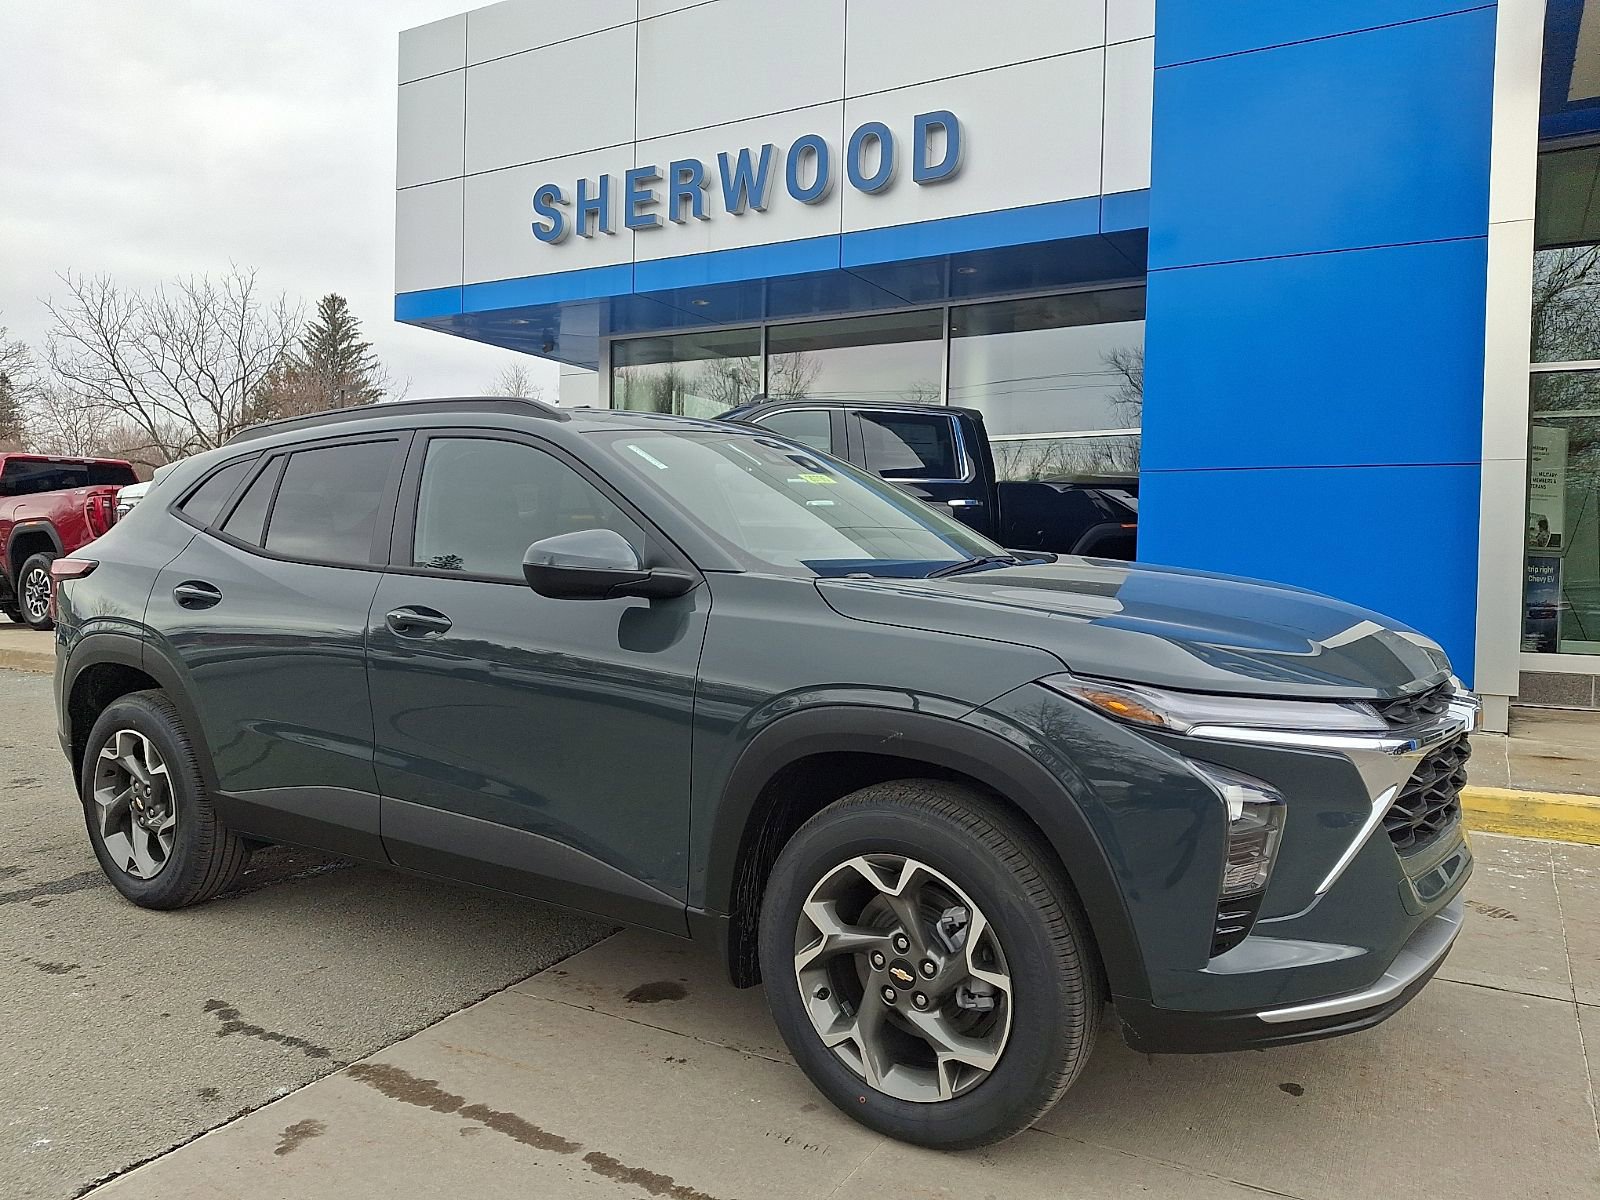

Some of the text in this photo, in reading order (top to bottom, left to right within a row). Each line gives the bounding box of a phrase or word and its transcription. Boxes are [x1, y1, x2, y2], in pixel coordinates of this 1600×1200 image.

[531, 110, 964, 244] SHERWOOD
[1540, 565, 1554, 575] right
[1528, 575, 1555, 584] Chevy EV
